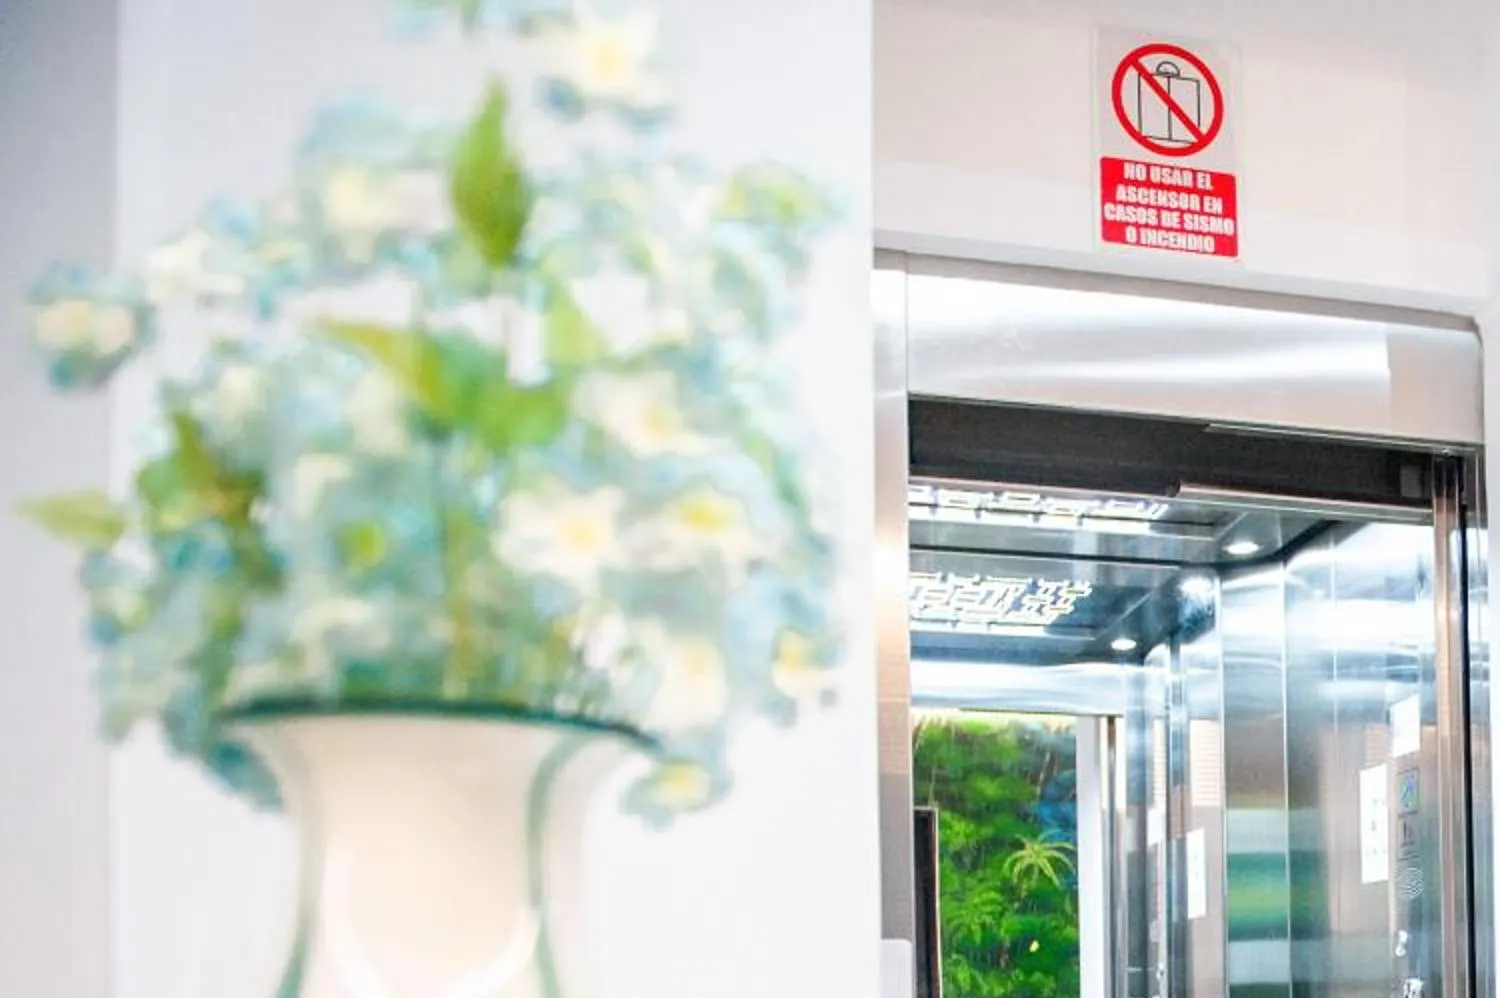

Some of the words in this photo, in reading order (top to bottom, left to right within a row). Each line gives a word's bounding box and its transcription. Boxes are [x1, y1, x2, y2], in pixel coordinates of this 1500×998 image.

[1123, 161, 1146, 181] NO
[1150, 165, 1193, 187] USAR
[1198, 172, 1213, 190] EL
[1116, 184, 1200, 211] ASCENSOR
[1204, 197, 1222, 214] EN
[1104, 203, 1157, 224] CASOS
[1161, 210, 1180, 228] DE
[1184, 214, 1234, 236] SISMO
[1126, 227, 1137, 244] O
[1140, 229, 1215, 253] INCENDIO
